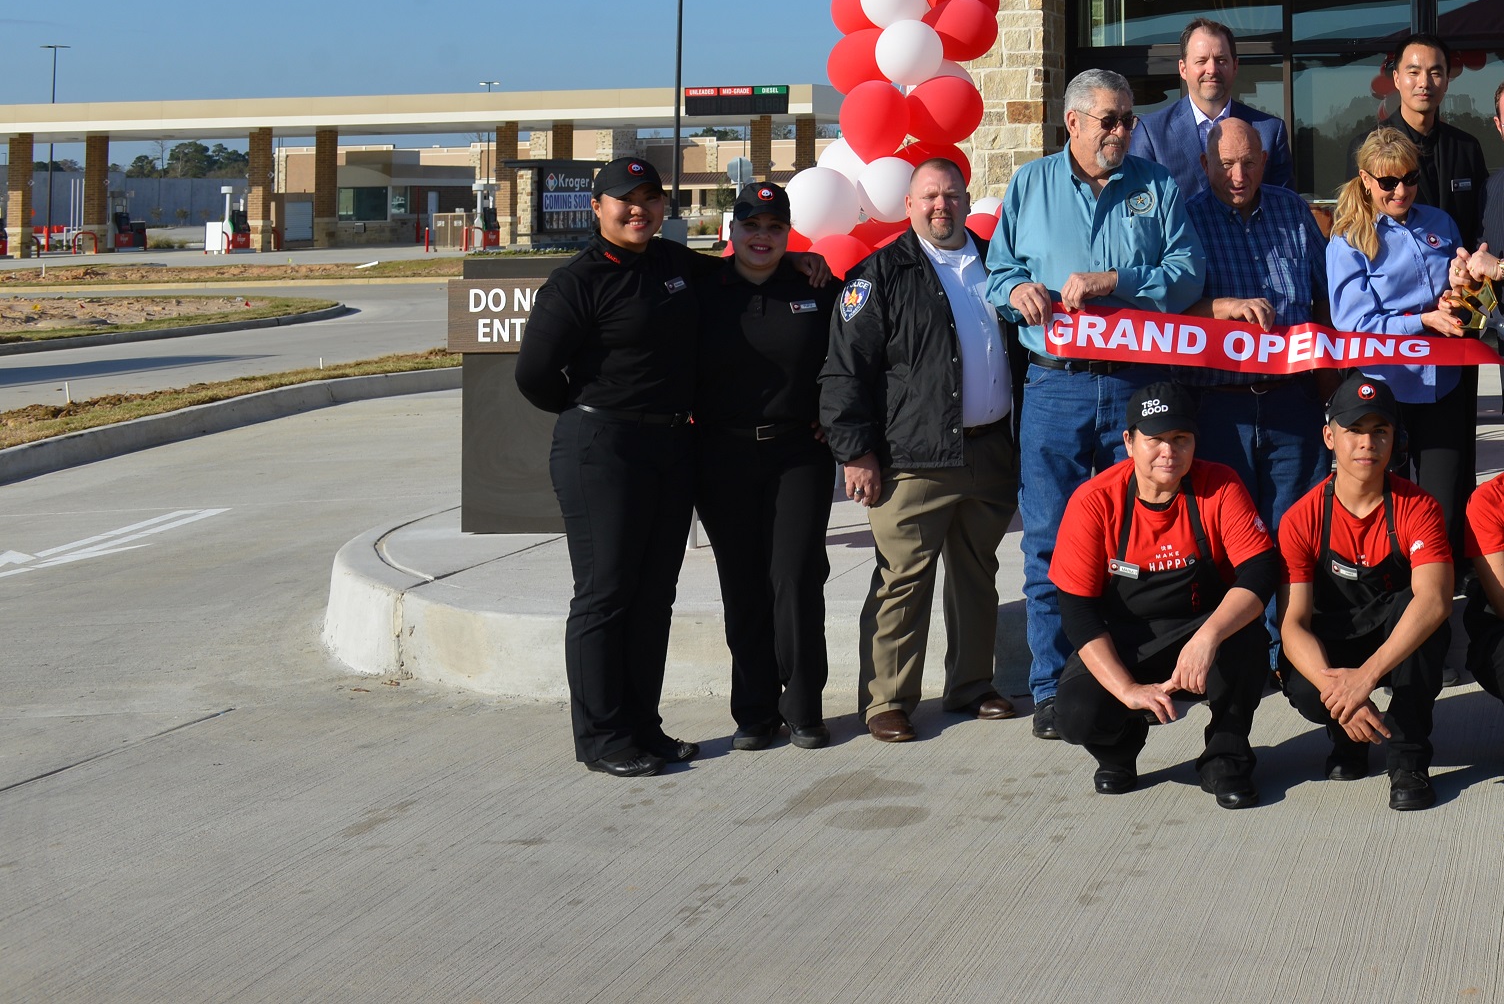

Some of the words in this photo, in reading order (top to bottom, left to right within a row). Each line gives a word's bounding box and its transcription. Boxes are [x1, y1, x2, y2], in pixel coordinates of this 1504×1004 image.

[722, 87, 750, 95] MID-GRADE
[558, 173, 590, 191] Kroger
[544, 194, 572, 210] COMING
[573, 194, 592, 209] SOON
[469, 288, 507, 313] DO
[477, 318, 528, 343] ENT
[1046, 312, 1208, 355] GRAND
[1222, 329, 1432, 364] OPENING
[1141, 399, 1160, 409] TSO
[1141, 404, 1169, 417] GOOD
[1155, 550, 1180, 559] MAKE
